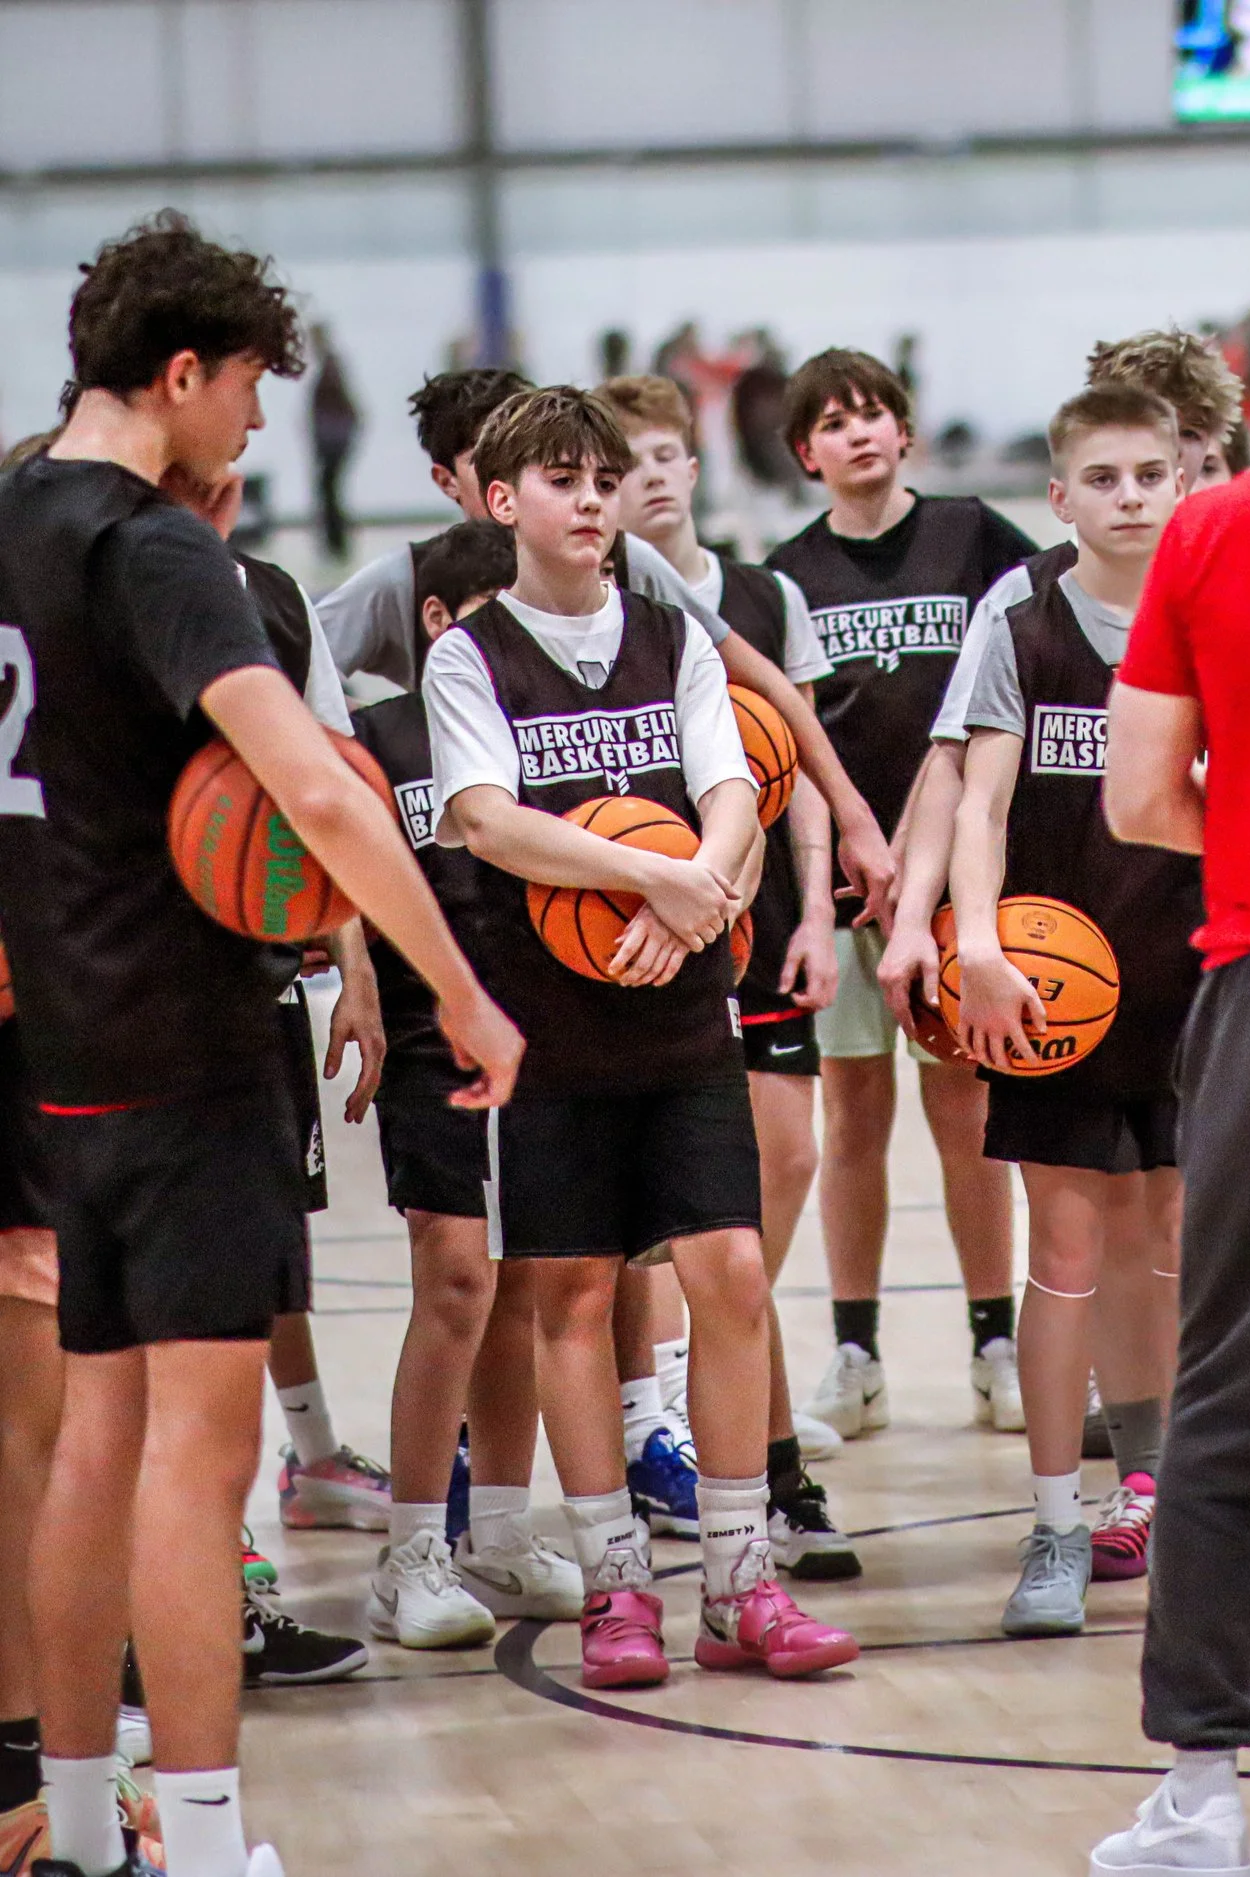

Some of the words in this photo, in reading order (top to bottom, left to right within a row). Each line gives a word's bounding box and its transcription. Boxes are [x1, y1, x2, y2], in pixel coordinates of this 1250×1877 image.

[914, 603, 961, 624] ELITE
[820, 624, 961, 656] ASKETBALL
[517, 718, 627, 752] MERCURY
